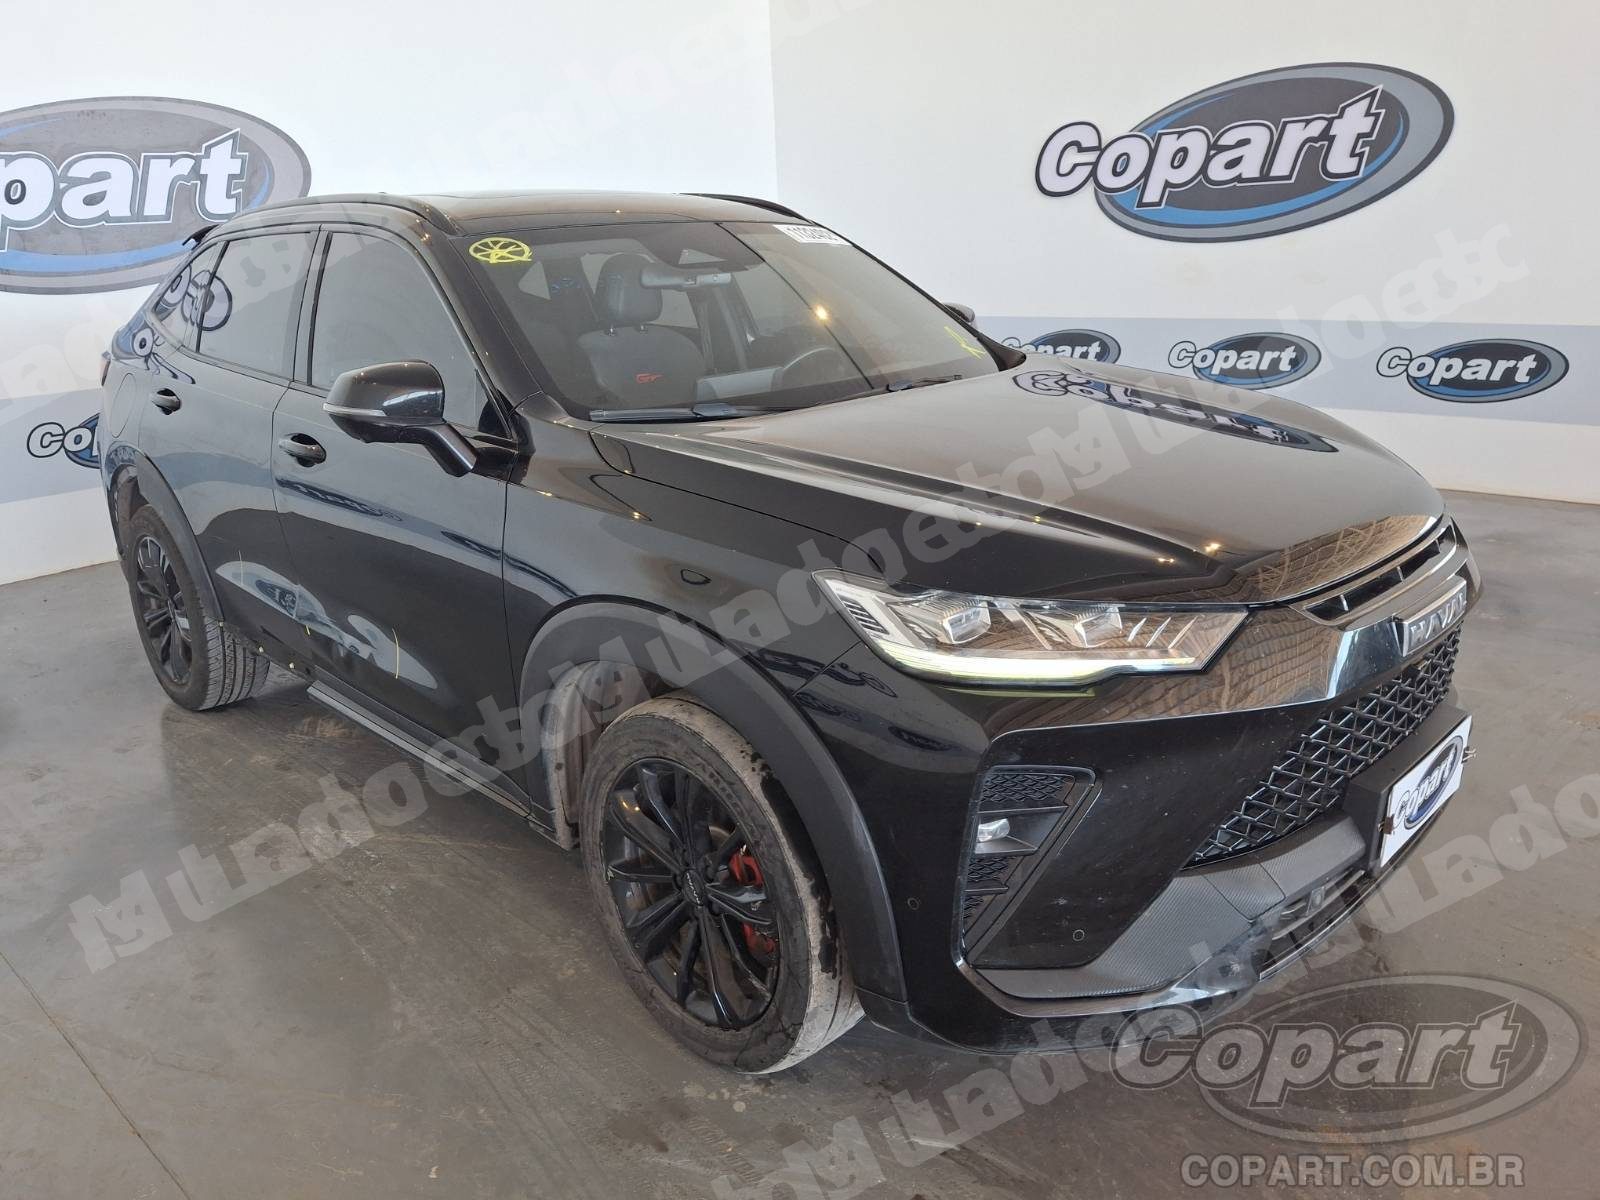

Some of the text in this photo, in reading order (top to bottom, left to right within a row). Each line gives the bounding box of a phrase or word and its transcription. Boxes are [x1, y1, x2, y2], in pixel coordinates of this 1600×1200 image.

[1035, 84, 1386, 210] Copart
[1168, 340, 1297, 376] Copart
[1376, 346, 1538, 387] Copart
[27, 421, 100, 458] Co
[1392, 741, 1457, 830] Copart
